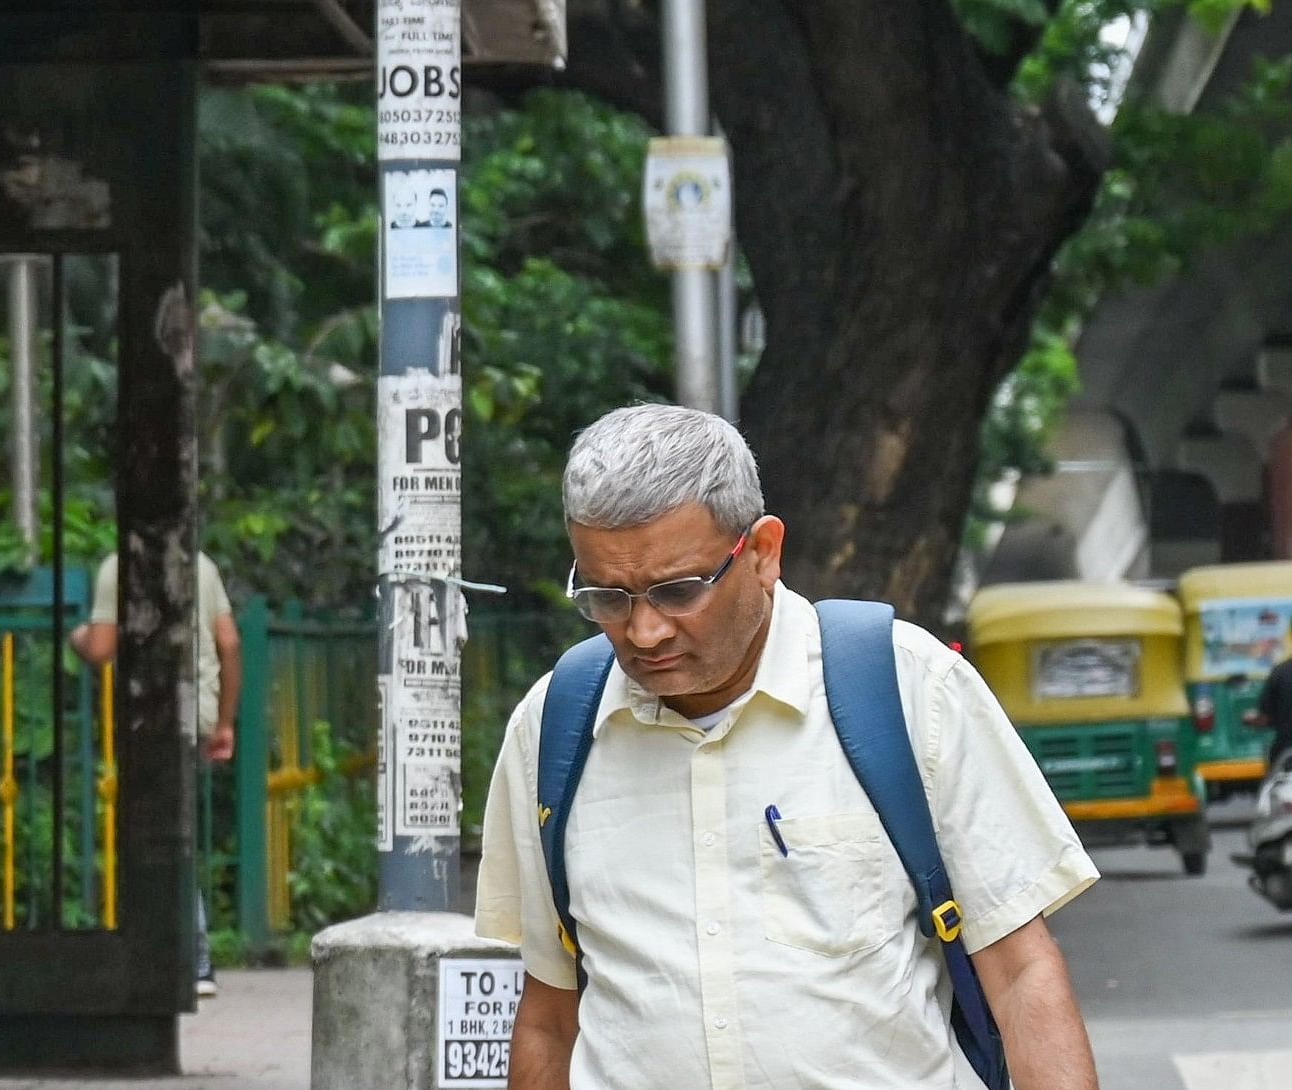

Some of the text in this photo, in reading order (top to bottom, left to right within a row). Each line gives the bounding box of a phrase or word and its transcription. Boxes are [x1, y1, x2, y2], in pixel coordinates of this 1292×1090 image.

[379, 65, 460, 99] JOBS
[392, 476, 419, 492] FOR
[424, 475, 453, 491] MEN
[461, 972, 495, 995] TO
[465, 1001, 503, 1015] FOR
[448, 1020, 454, 1034] 1
[493, 1020, 499, 1034] 2
[448, 1042, 510, 1077] 93425
